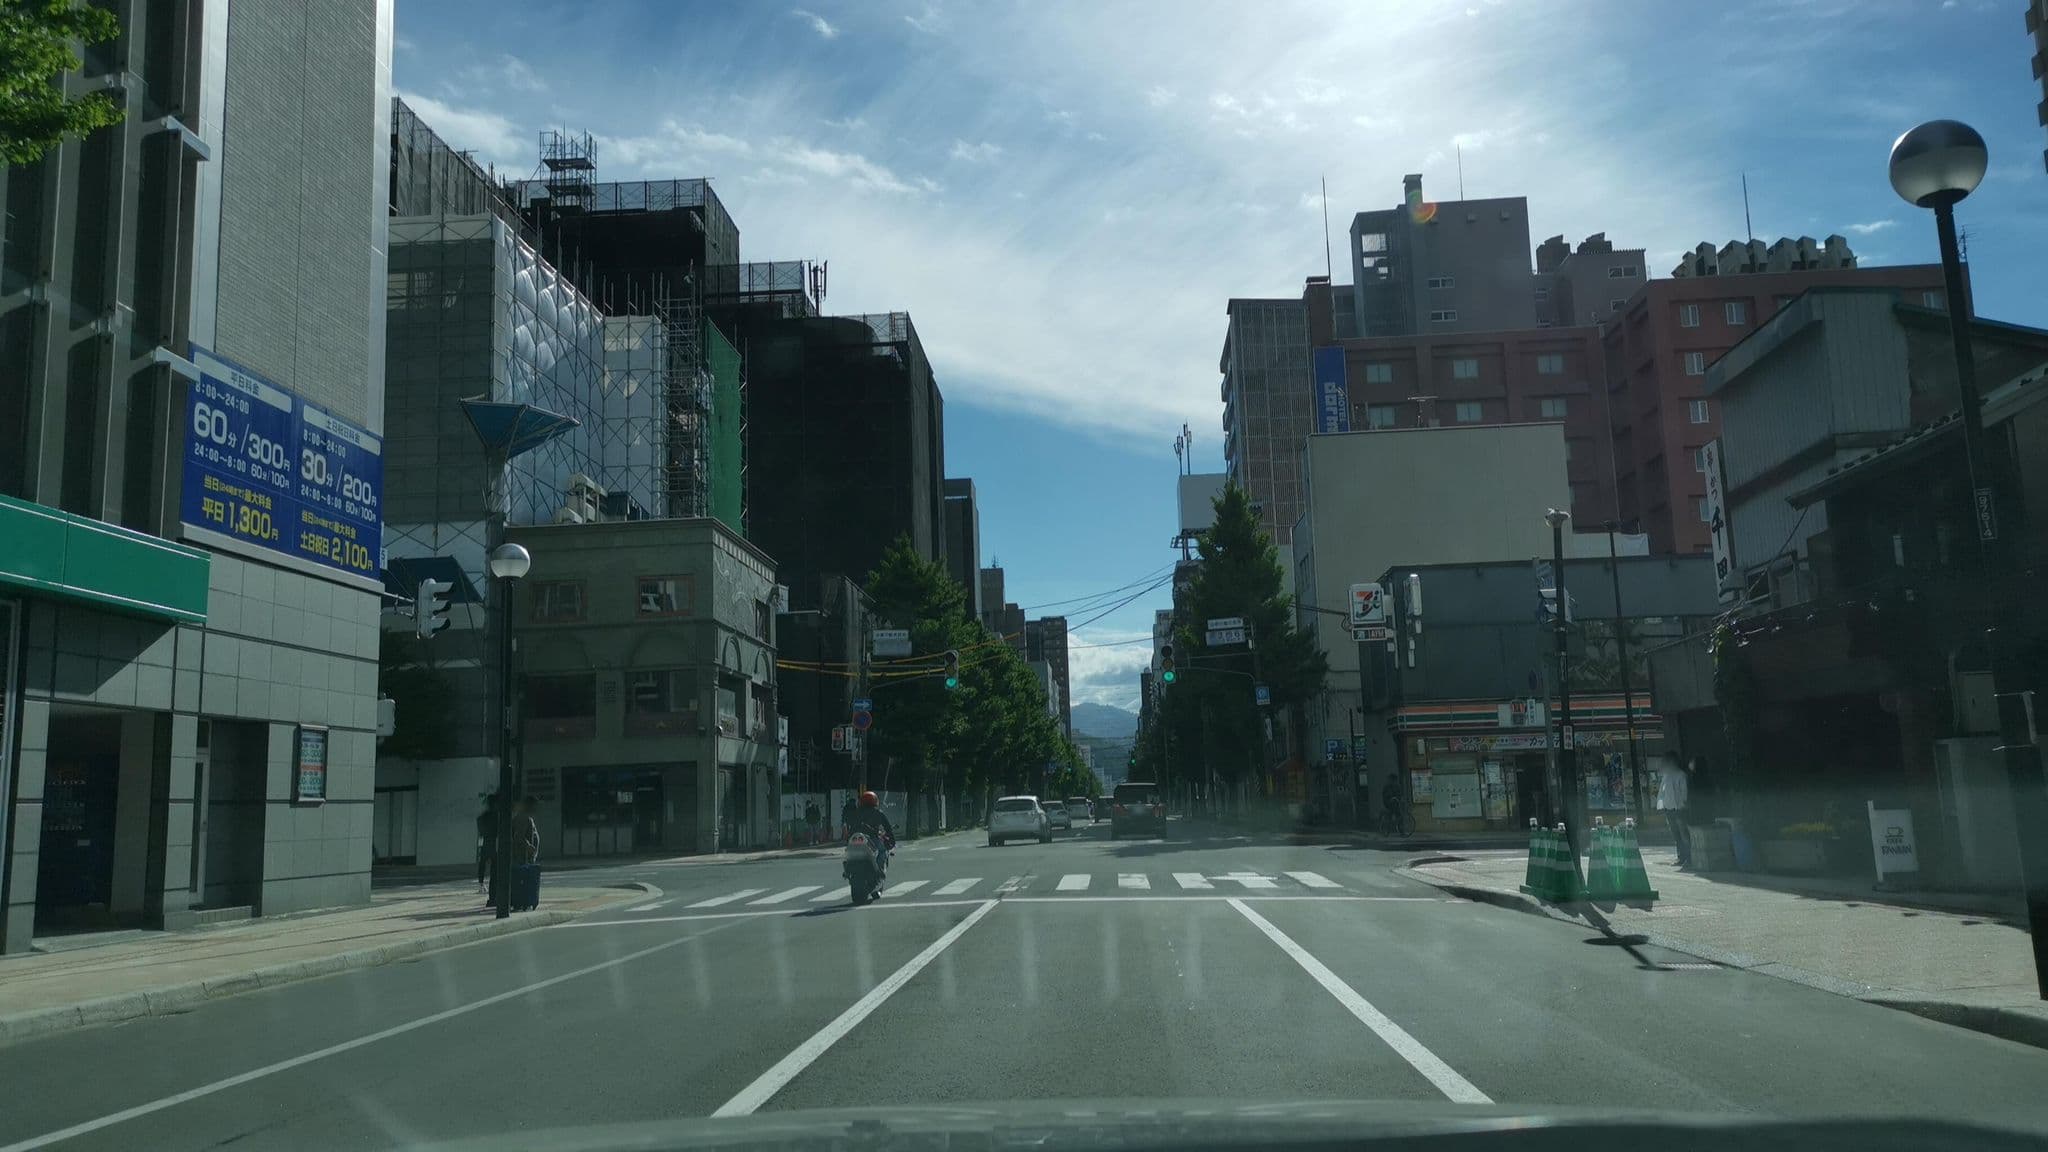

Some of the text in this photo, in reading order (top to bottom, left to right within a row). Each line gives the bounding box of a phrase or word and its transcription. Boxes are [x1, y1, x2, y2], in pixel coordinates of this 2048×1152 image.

[202, 497, 279, 541] 平日 1,300円
[331, 537, 374, 571] 2,100円
